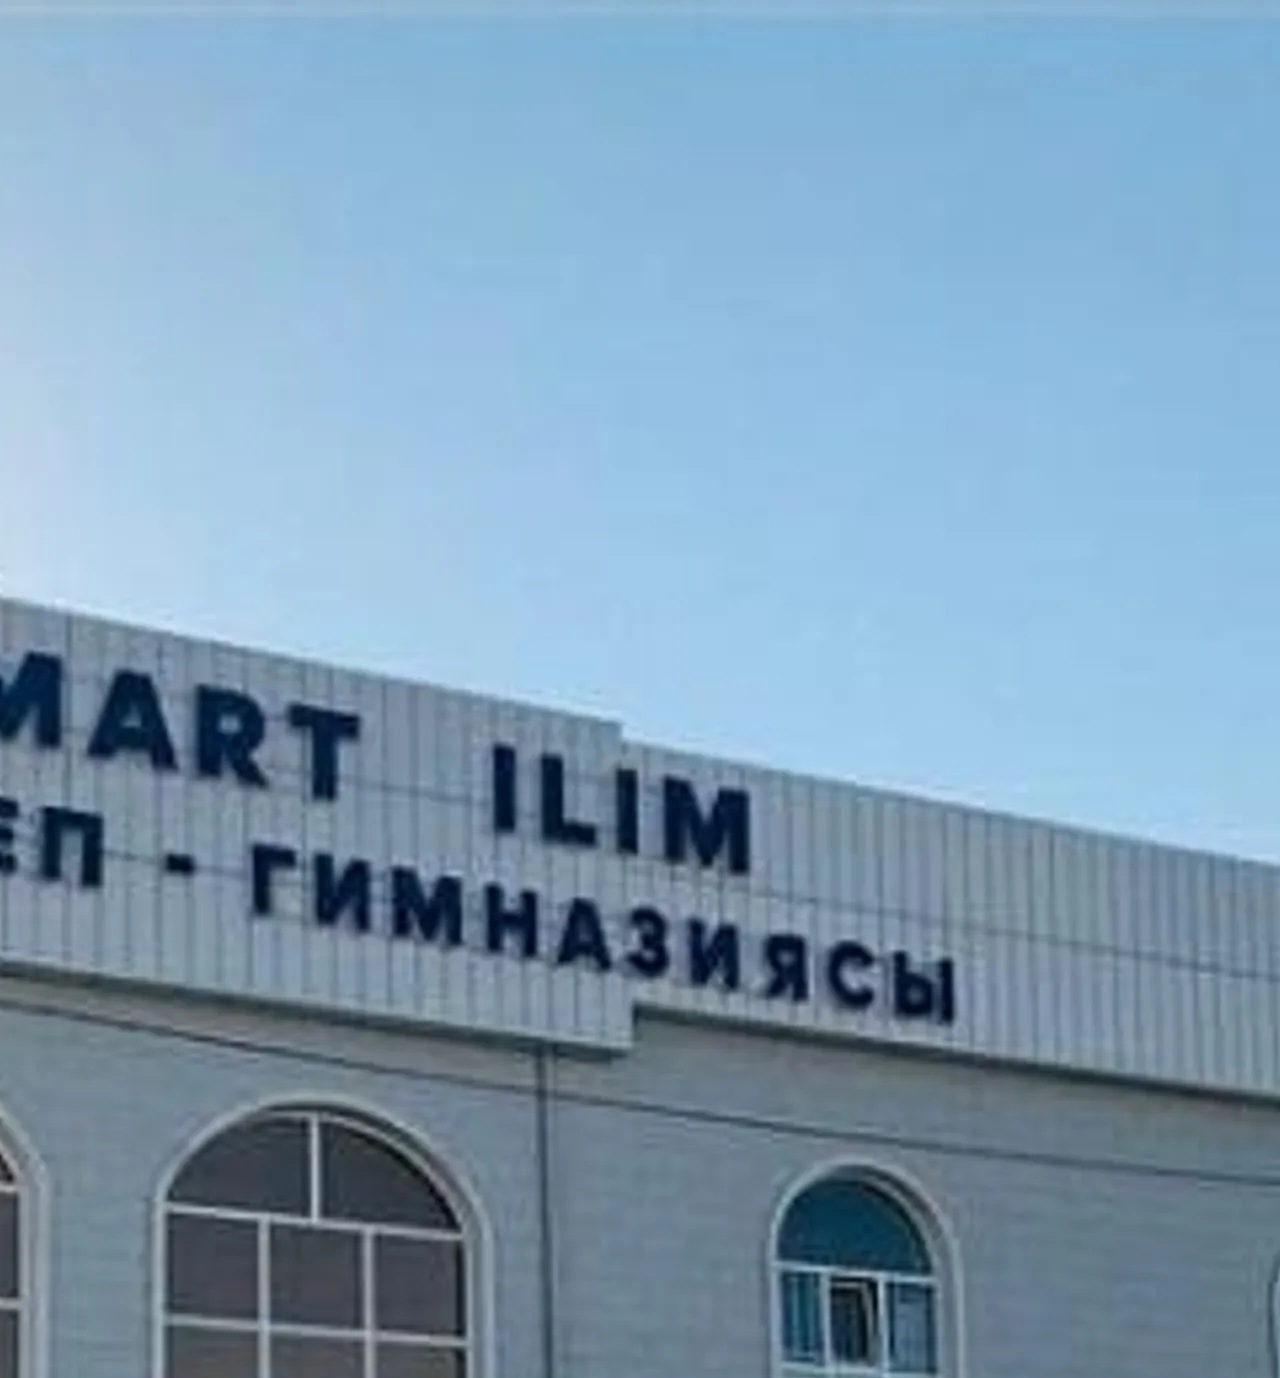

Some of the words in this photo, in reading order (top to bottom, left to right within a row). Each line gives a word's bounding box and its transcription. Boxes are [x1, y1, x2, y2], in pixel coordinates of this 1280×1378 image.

[491, 743, 753, 877] ILIM
[161, 852, 198, 878] -
[249, 843, 956, 1026] ГИМНАЗИЯСЫ
